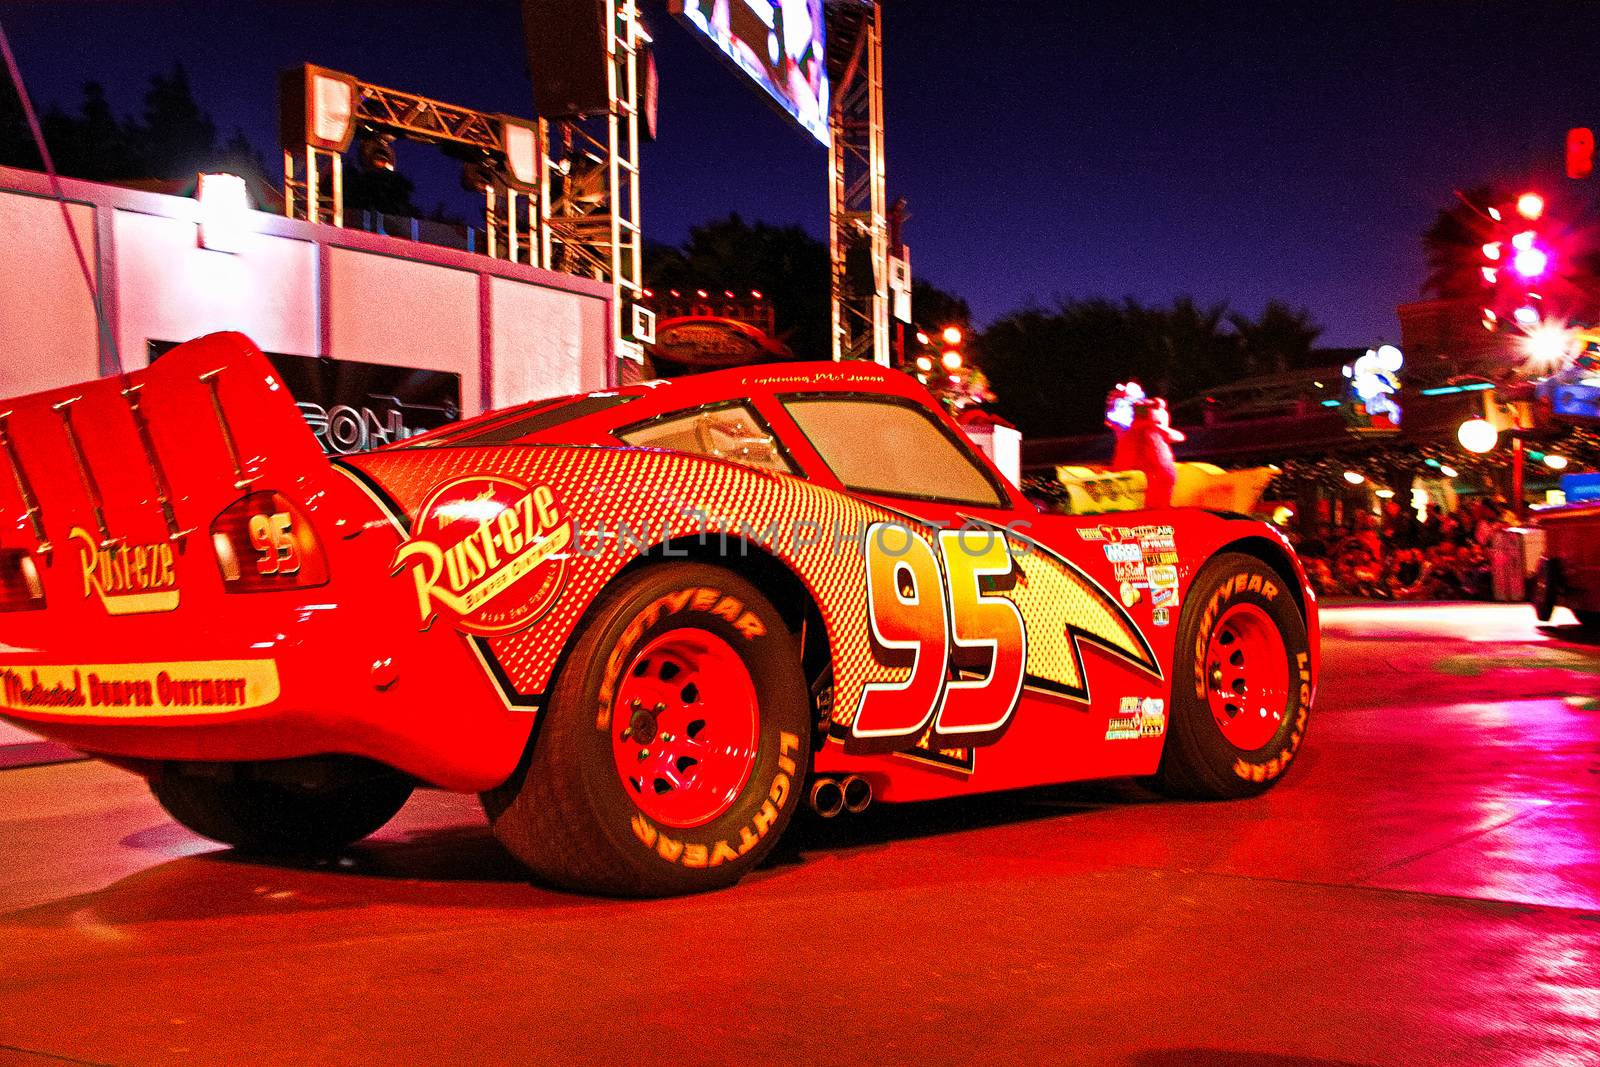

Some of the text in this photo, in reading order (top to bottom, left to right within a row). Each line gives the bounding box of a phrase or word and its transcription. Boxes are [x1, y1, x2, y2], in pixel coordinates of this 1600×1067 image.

[249, 511, 301, 577] 95
[852, 522, 1028, 738] 95
[630, 730, 800, 869] LIGHTYEAR
